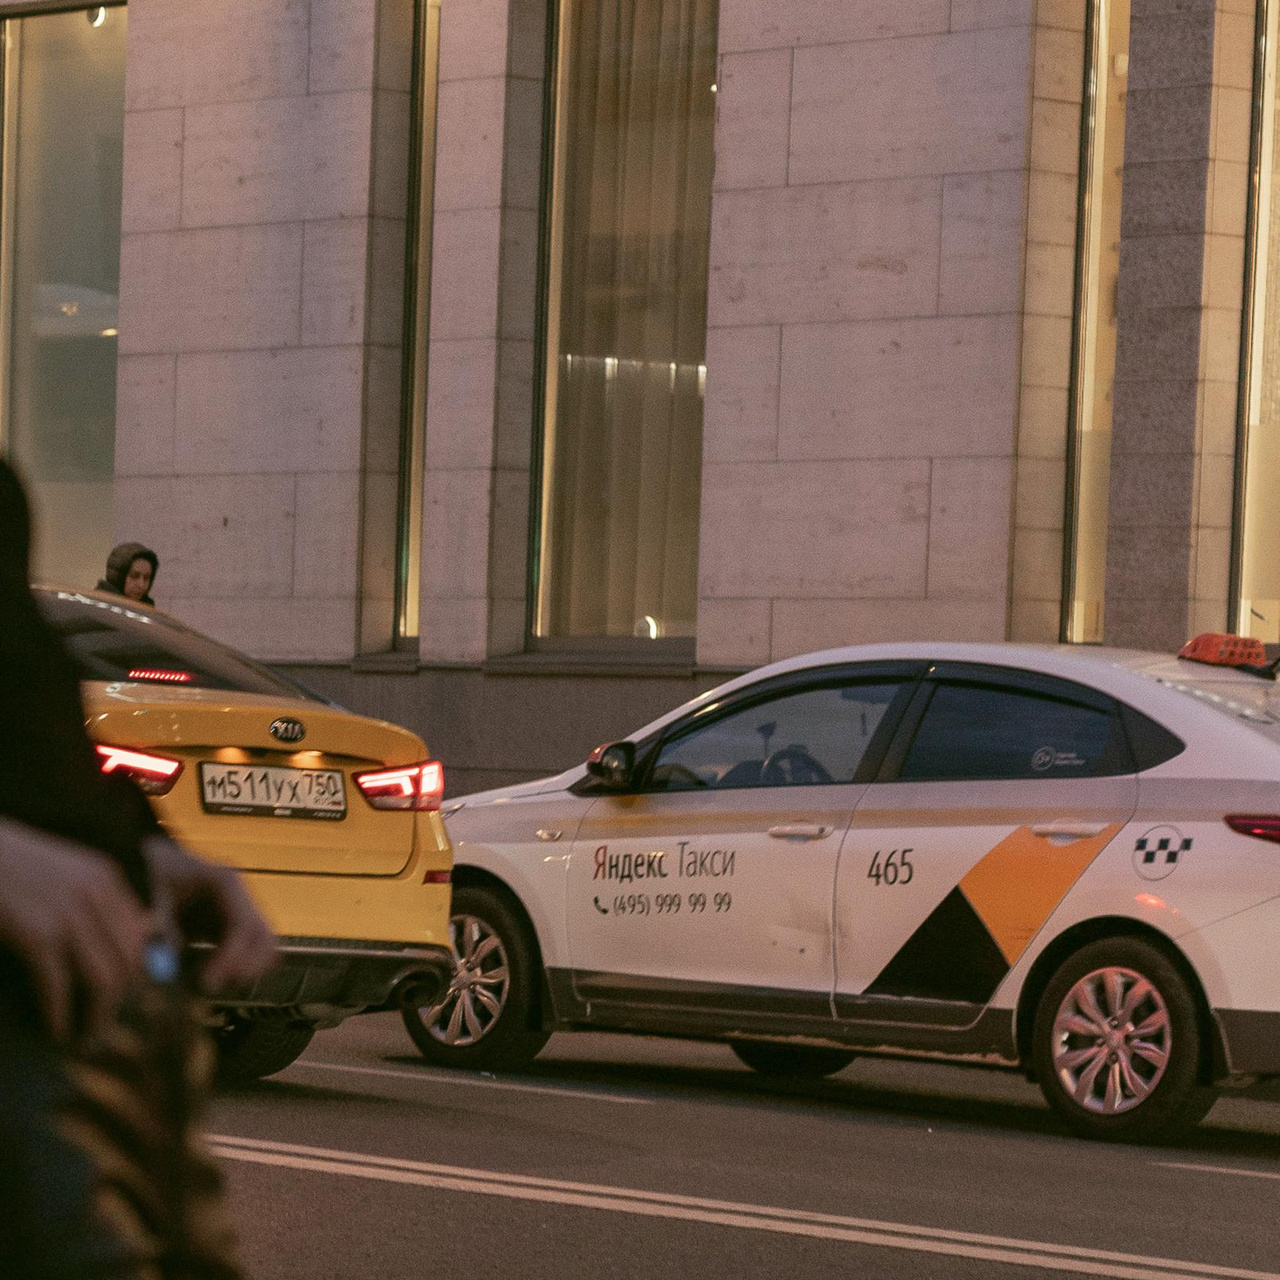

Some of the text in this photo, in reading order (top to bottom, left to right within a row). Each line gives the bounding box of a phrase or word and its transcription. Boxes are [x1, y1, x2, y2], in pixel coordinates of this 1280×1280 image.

[275, 721, 302, 739] KIA
[592, 841, 736, 884] Яндекс Такси
[867, 848, 915, 887] 465
[613, 891, 733, 917] (495) 999 99 99
